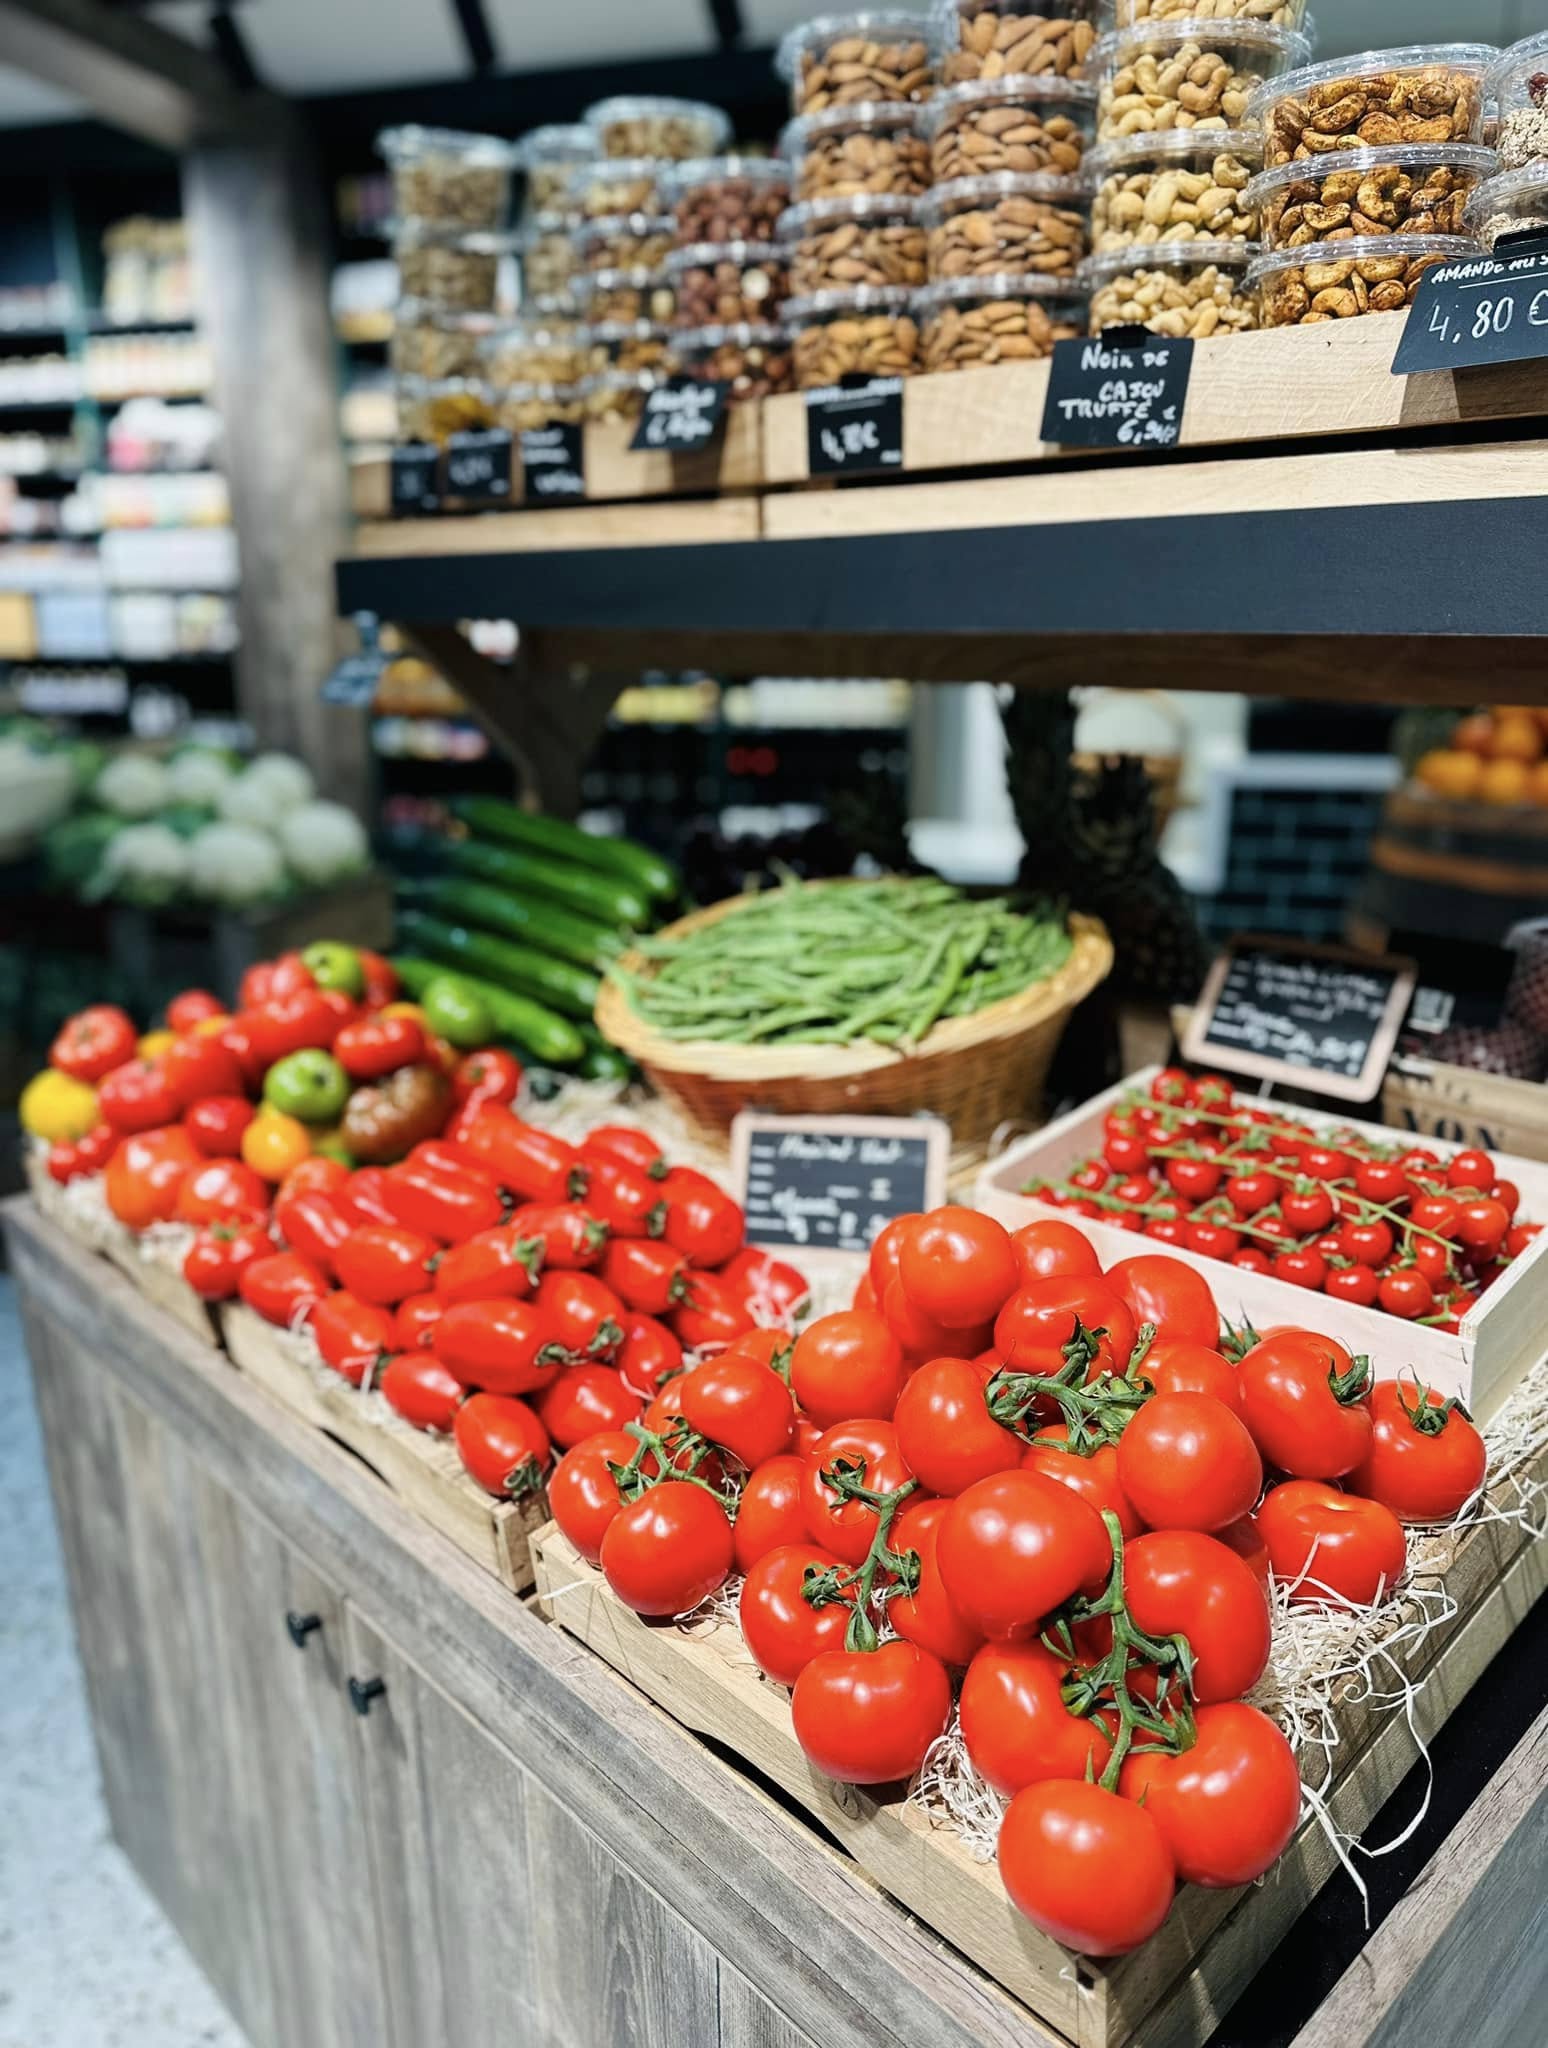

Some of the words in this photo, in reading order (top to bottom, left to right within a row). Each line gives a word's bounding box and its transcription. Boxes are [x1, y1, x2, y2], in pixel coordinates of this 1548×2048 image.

[1428, 296, 1515, 344] 4,80
[1142, 350, 1170, 368] DE
[1099, 379, 1165, 402] CAJOU
